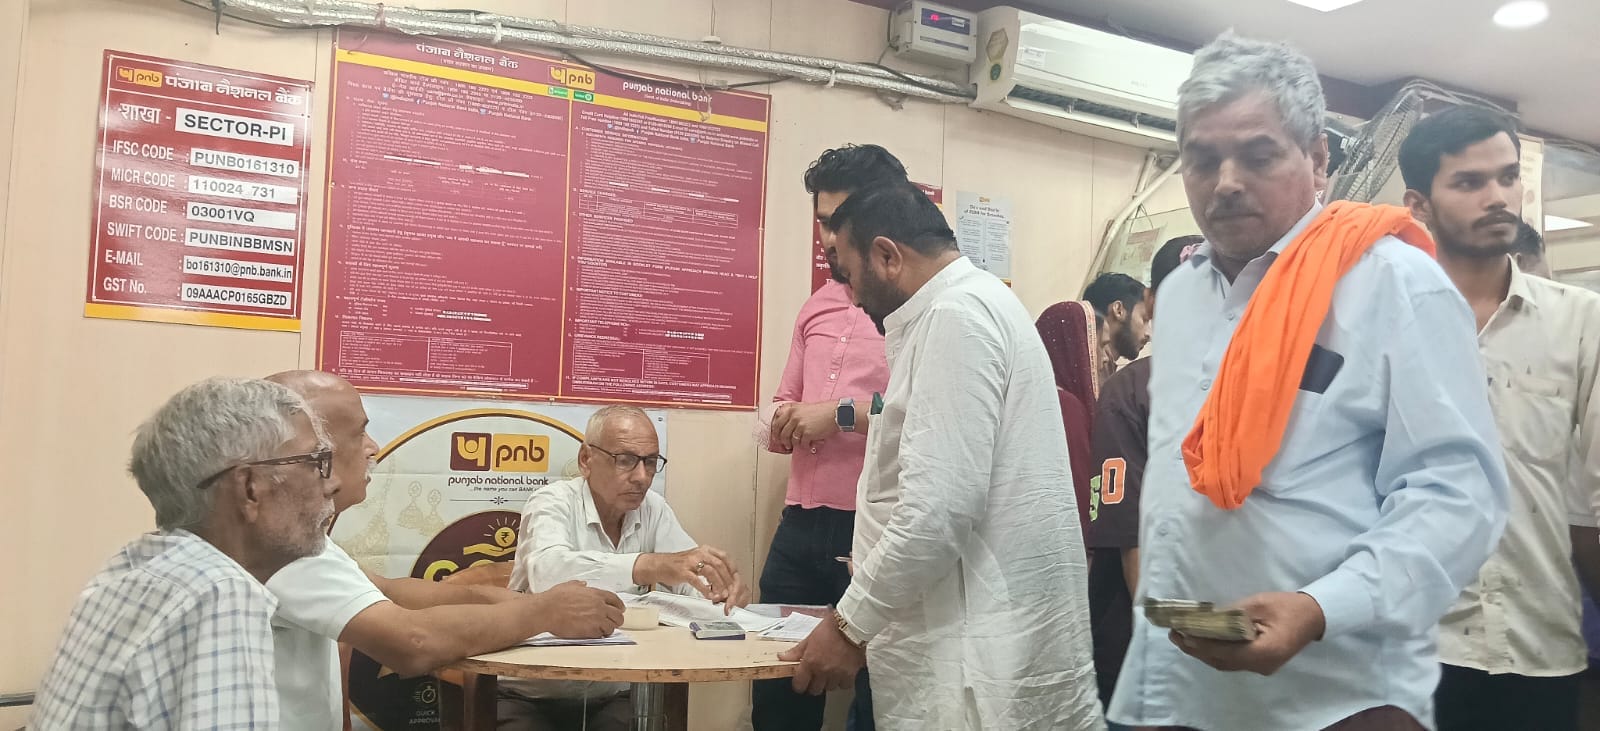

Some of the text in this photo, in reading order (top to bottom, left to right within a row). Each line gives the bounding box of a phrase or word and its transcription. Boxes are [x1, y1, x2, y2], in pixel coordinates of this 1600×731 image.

[136, 72, 159, 84] pnb
[569, 74, 592, 84] pnb
[623, 82, 653, 92] punjab
[655, 88, 690, 100] national
[118, 103, 161, 124] शाखा
[184, 114, 286, 140] SECTOR-PI
[113, 140, 139, 156] IFSC
[141, 144, 174, 161] CODE
[194, 152, 294, 174] PUNB0161310
[111, 168, 140, 184] MICR
[142, 172, 175, 188] CODE
[193, 178, 243, 194] 110024
[252, 186, 276, 198] 731
[109, 194, 133, 210] BSR
[136, 198, 168, 214] CODE
[191, 205, 255, 222] 03001VQ
[107, 222, 142, 239] SWIFT
[144, 226, 177, 242] CODE
[189, 232, 293, 252] PUNBINBBMSN
[105, 250, 144, 266] E-MAIL
[186, 258, 292, 278] bo161310@pnb.bank.in
[103, 276, 126, 292] GST
[129, 280, 147, 294] No.
[186, 287, 287, 305] 09AAACP0165GBZD
[496, 439, 545, 467] pnb
[448, 476, 549, 486] punjab national bank
